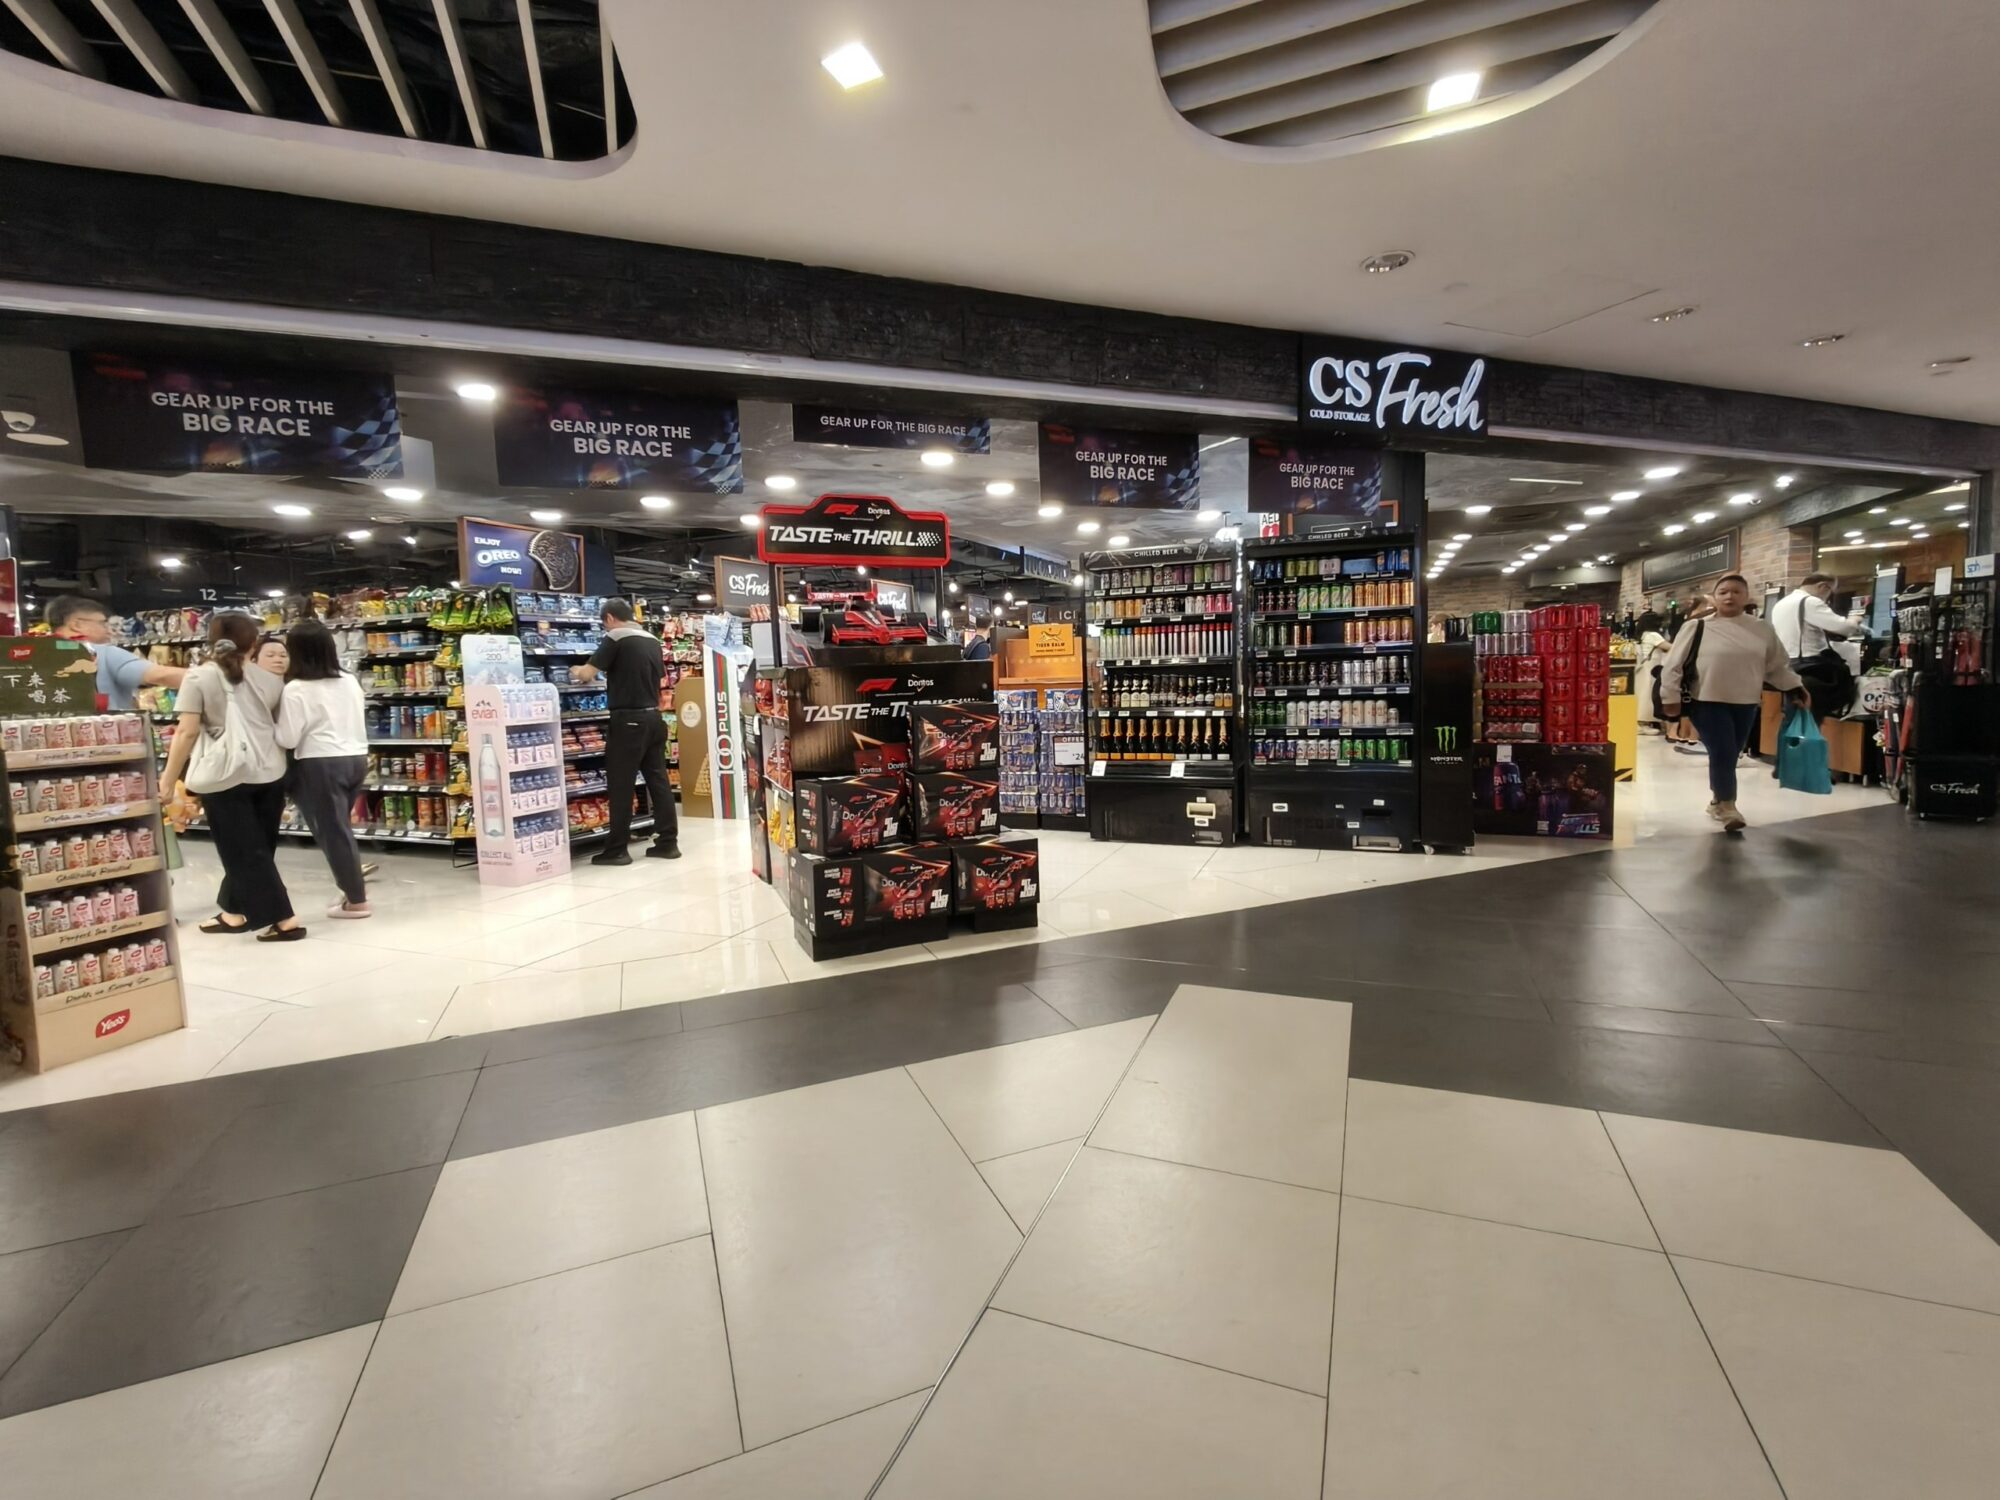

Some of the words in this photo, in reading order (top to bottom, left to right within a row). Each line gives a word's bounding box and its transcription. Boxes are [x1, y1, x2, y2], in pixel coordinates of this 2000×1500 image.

[1309, 357, 1372, 407] CS
[1376, 351, 1485, 431] Fresh
[151, 392, 211, 408] GEAR
[216, 395, 244, 410] UP
[249, 397, 291, 413] FOR
[295, 400, 335, 416] THE
[1310, 409, 1334, 420] COLD
[1334, 410, 1371, 422] STORAGE
[182, 413, 232, 433] BIG
[237, 415, 311, 437] RACE
[550, 419, 596, 434] GEAR
[600, 422, 621, 435] UP
[625, 423, 658, 437] FOR
[661, 425, 691, 439] THE
[820, 415, 850, 427] GEAR
[853, 418, 869, 428] UP
[870, 419, 893, 431] FOR
[895, 421, 916, 432] THE
[917, 423, 936, 434] BIG
[937, 424, 966, 436] RACE
[573, 437, 611, 454] BIG
[615, 439, 673, 457] RACE
[1075, 451, 1105, 462] GEAR
[1107, 452, 1122, 464] UP
[1124, 453, 1146, 465] FOR
[1148, 455, 1167, 466] THE
[1090, 465, 1115, 479] BIG
[1117, 466, 1155, 481] RACE
[1280, 463, 1304, 473] GEAR
[1306, 464, 1318, 474] UP
[1319, 465, 1337, 475] FOR
[1339, 466, 1355, 476] THE
[1291, 476, 1311, 488] BIG
[1313, 477, 1344, 490] RACE
[1262, 513, 1280, 524] AED
[474, 536, 501, 547] ENJOY
[769, 525, 834, 543] TASTE
[833, 533, 851, 542] THE
[851, 529, 917, 546] THRILL
[477, 550, 520, 565] OREO
[500, 566, 522, 575] NOW!
[729, 574, 745, 590] CS
[199, 588, 217, 601] 12
[908, 679, 934, 687] Doritos
[472, 708, 497, 719] evian
[803, 703, 871, 722] TASTE
[871, 706, 890, 716] THE
[100, 1015, 126, 1034] Yeo's
